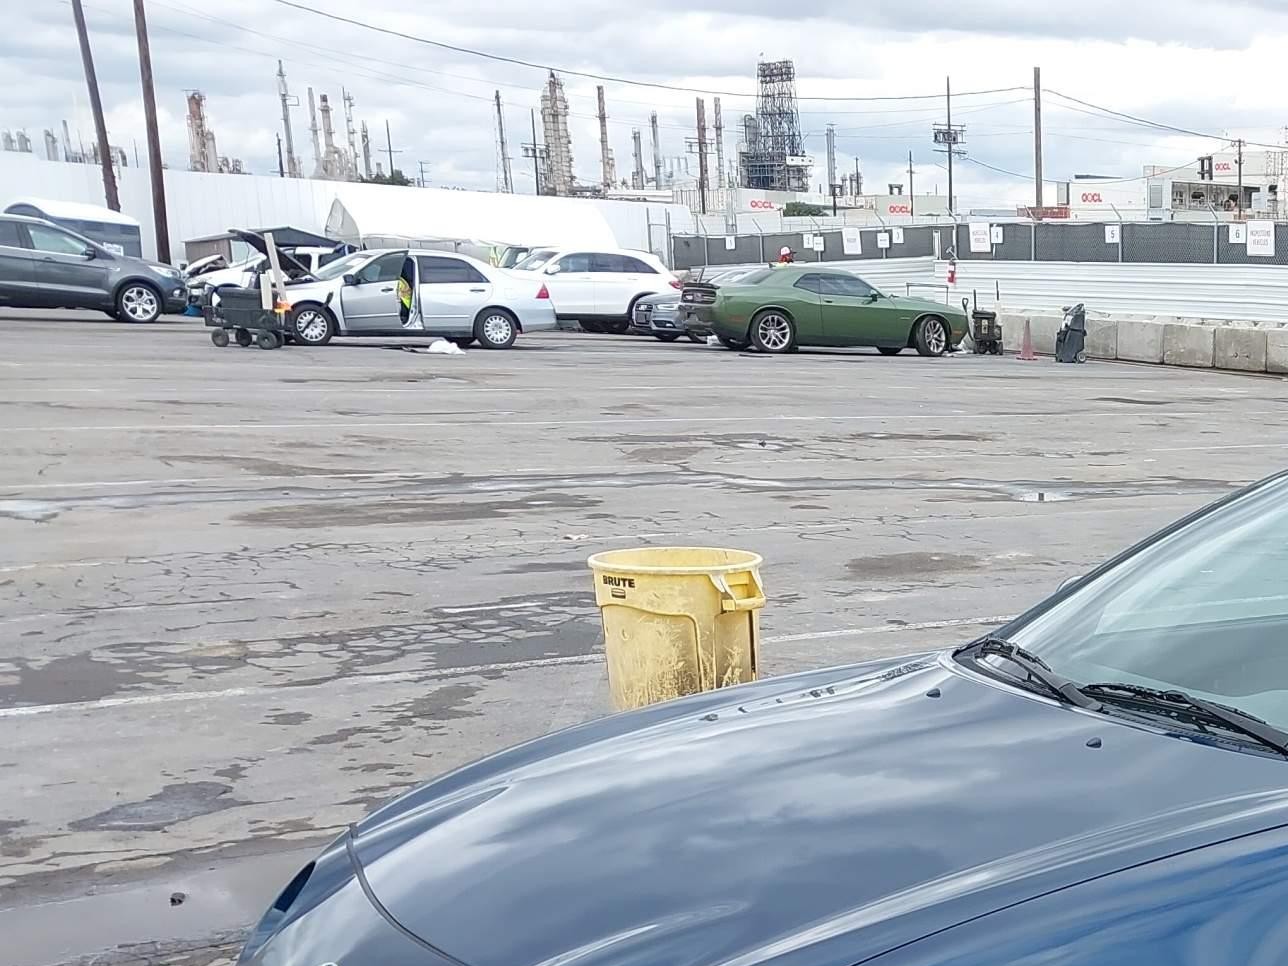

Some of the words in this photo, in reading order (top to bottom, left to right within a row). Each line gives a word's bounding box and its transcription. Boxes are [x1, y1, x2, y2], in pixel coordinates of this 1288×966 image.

[1215, 163, 1231, 171] OOCL
[1081, 192, 1103, 203] OOCL
[750, 200, 775, 209] OOCL
[889, 205, 911, 214] OOCL
[1110, 230, 1115, 239] 5
[1235, 229, 1240, 238] 6
[602, 575, 636, 588] BRUTE
